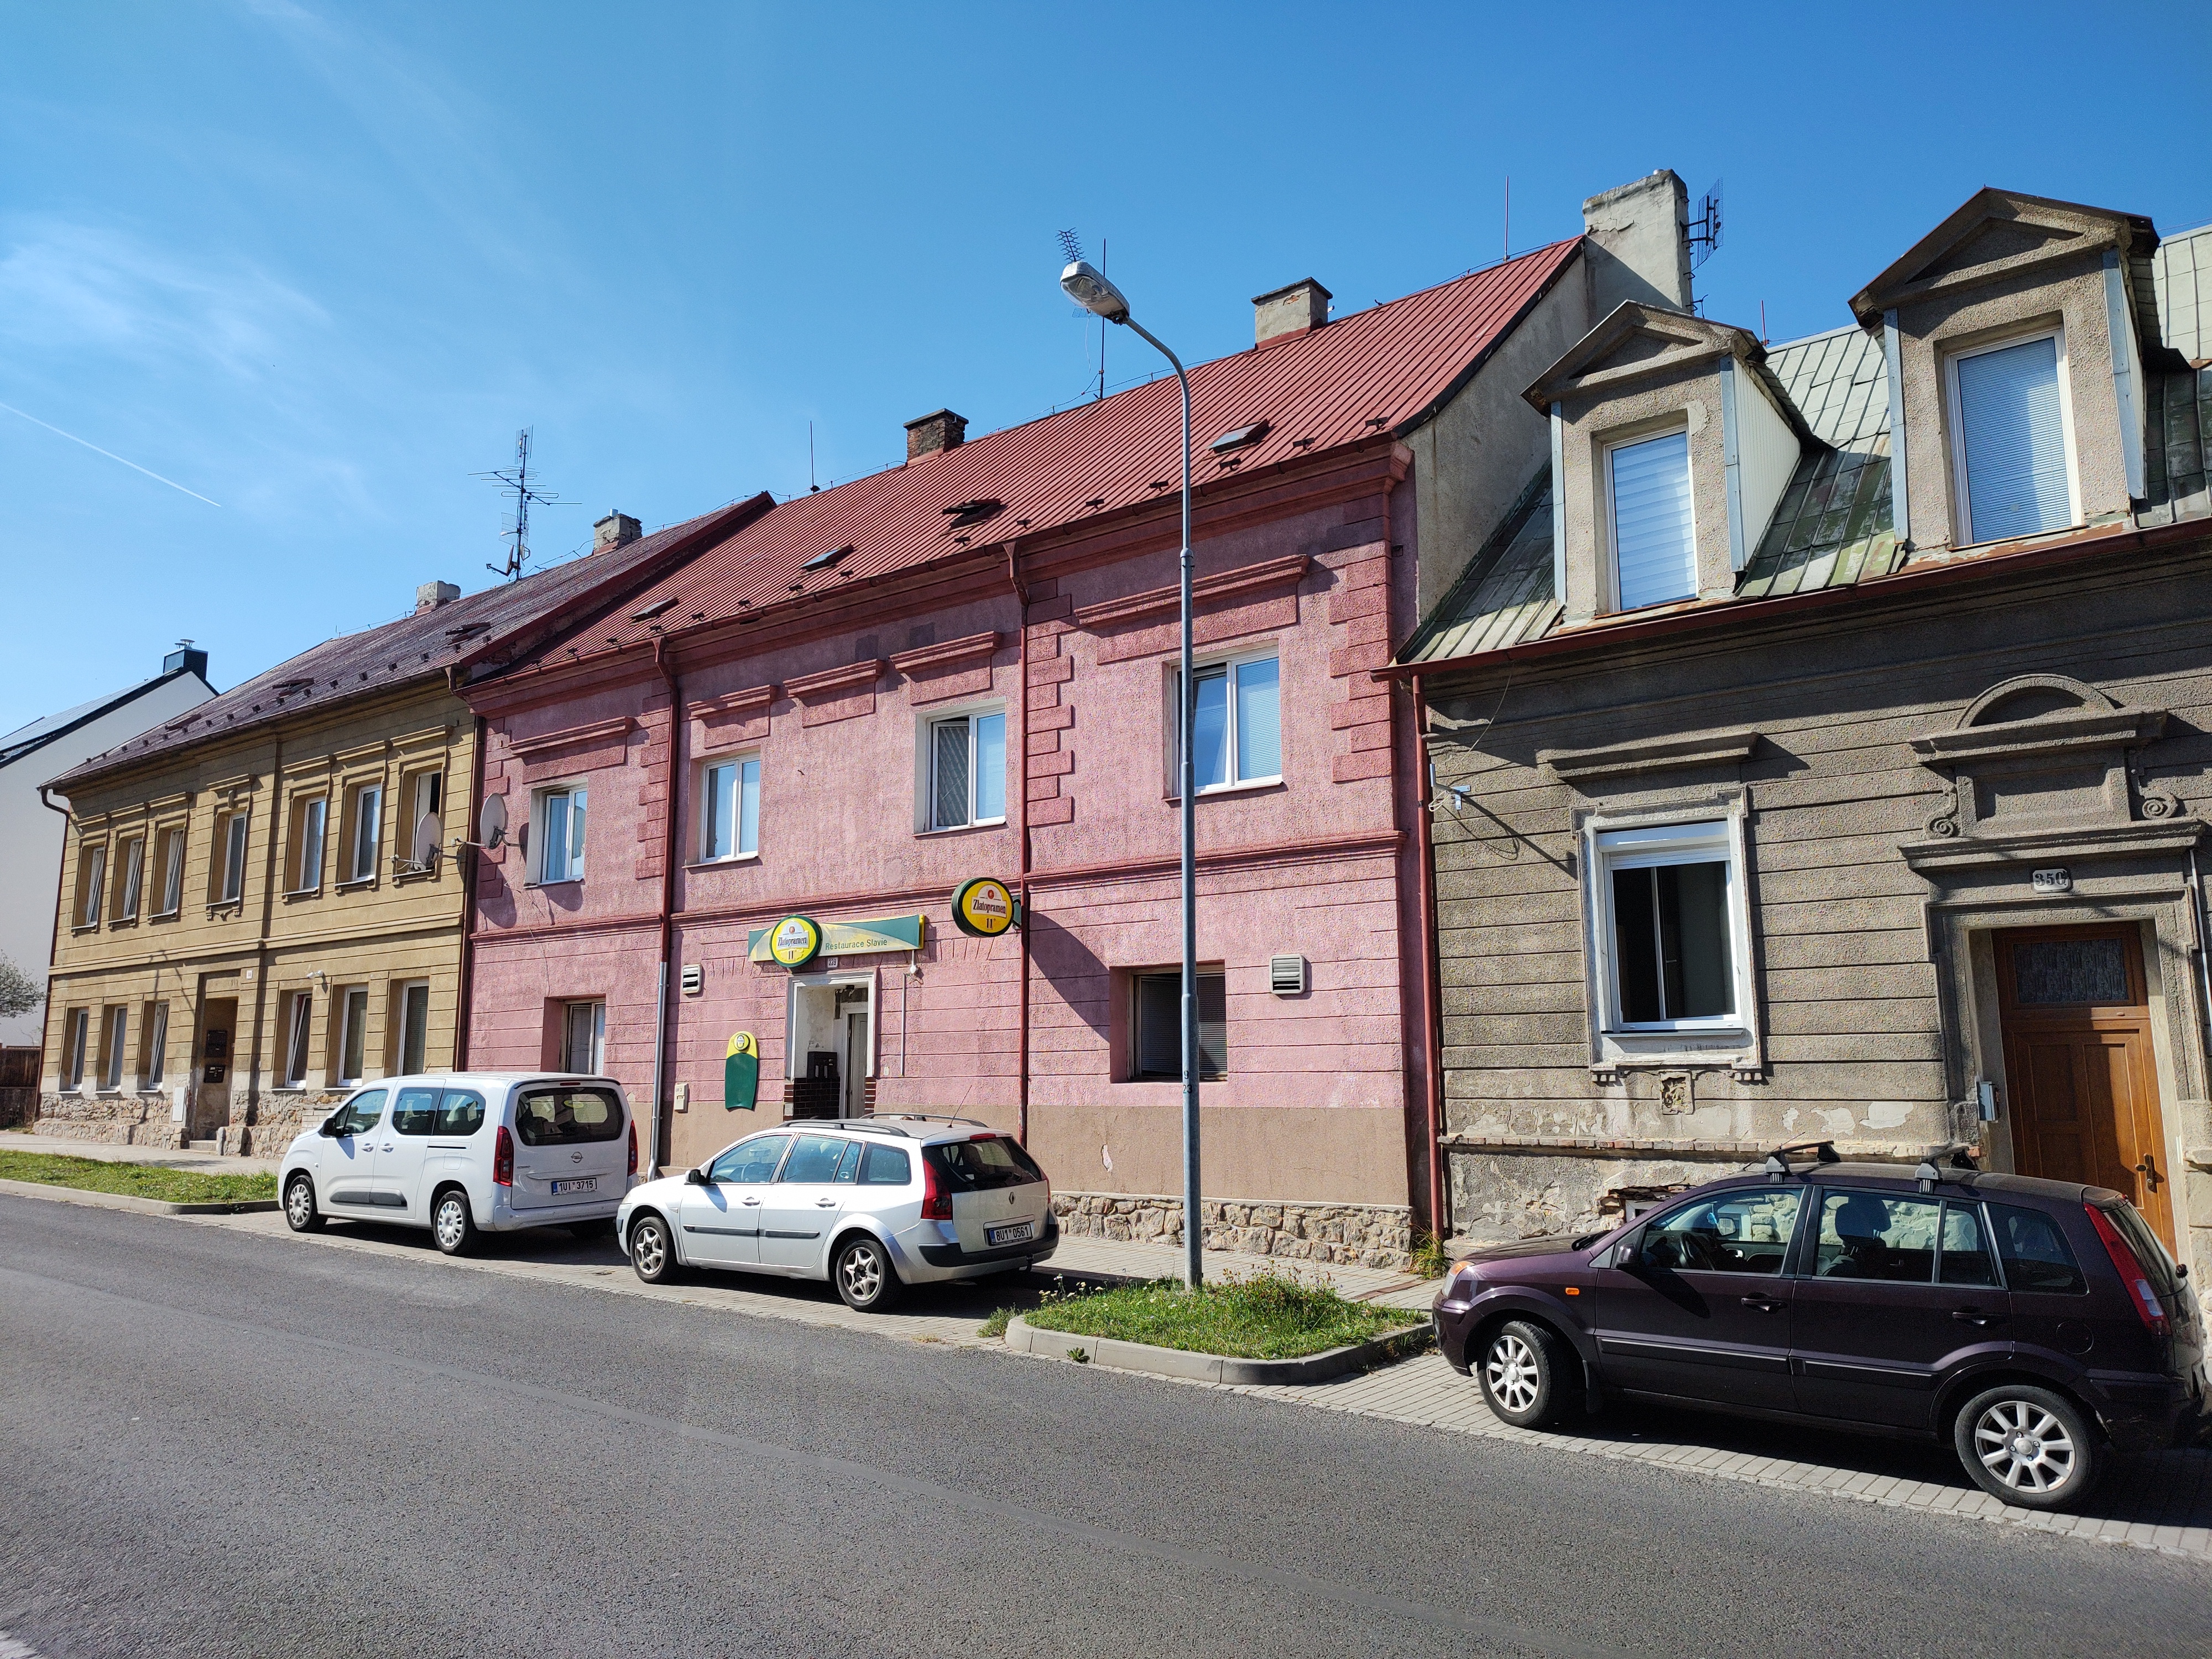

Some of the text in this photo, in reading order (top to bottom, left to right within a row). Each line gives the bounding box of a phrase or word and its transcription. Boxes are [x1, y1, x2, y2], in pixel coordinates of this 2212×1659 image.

[973, 899, 1005, 914] Zlatopramen
[778, 937, 807, 947] Zlatopramen
[825, 938, 888, 950] Restaurace Slavie
[1184, 1070, 1189, 1079] 9
[1183, 1084, 1193, 1094] 23
[576, 1180, 593, 1190] 3715
[1013, 1226, 1029, 1238] 0561
